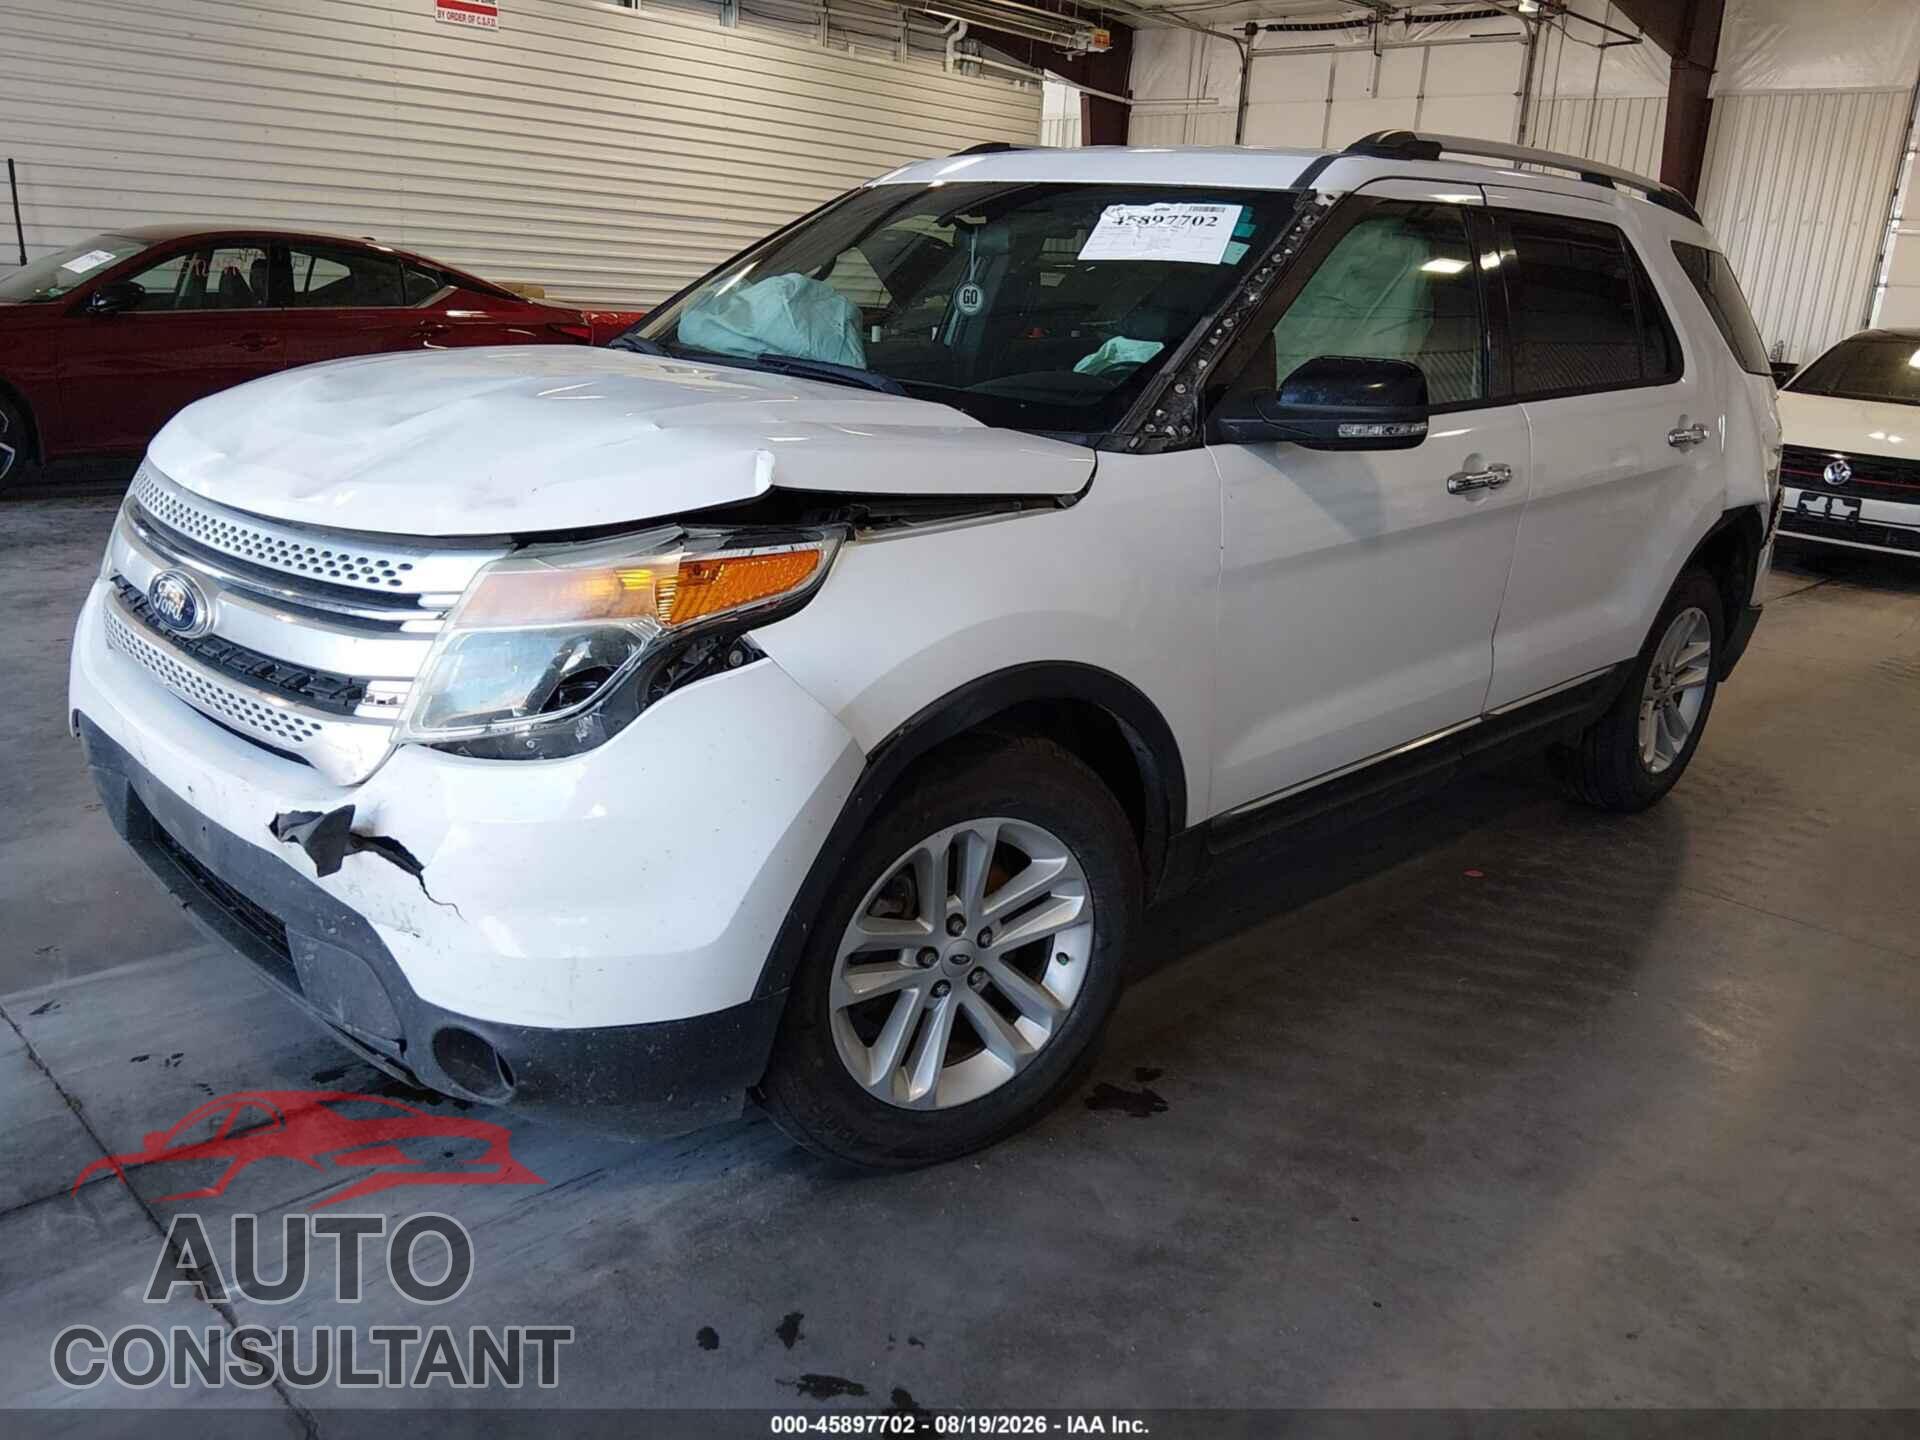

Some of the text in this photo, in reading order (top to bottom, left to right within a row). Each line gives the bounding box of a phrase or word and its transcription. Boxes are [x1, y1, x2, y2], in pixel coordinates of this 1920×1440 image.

[437, 10, 445, 18] BY
[447, 11, 466, 22] ORDER
[468, 14, 476, 24] OF
[1111, 214, 1219, 227] 45897702
[963, 288, 978, 305] GO
